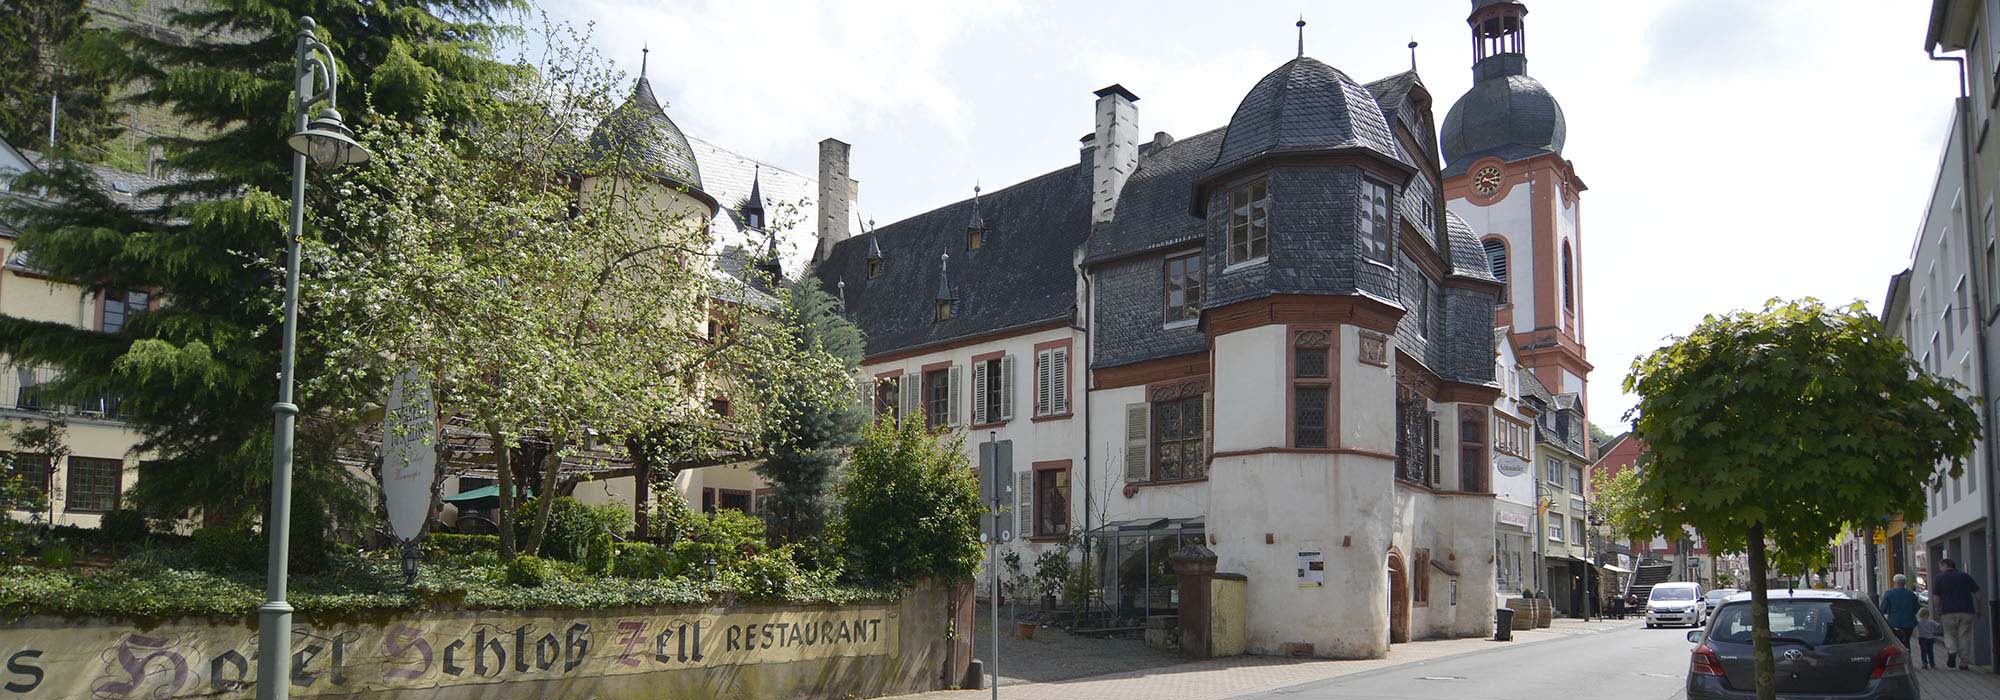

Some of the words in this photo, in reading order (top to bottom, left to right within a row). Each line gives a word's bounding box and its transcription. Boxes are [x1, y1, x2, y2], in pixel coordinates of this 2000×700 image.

[94, 632, 349, 697] Hoel
[386, 622, 590, 683] Schloß
[617, 619, 705, 668] Zell
[726, 618, 882, 653] RESTAURANT
